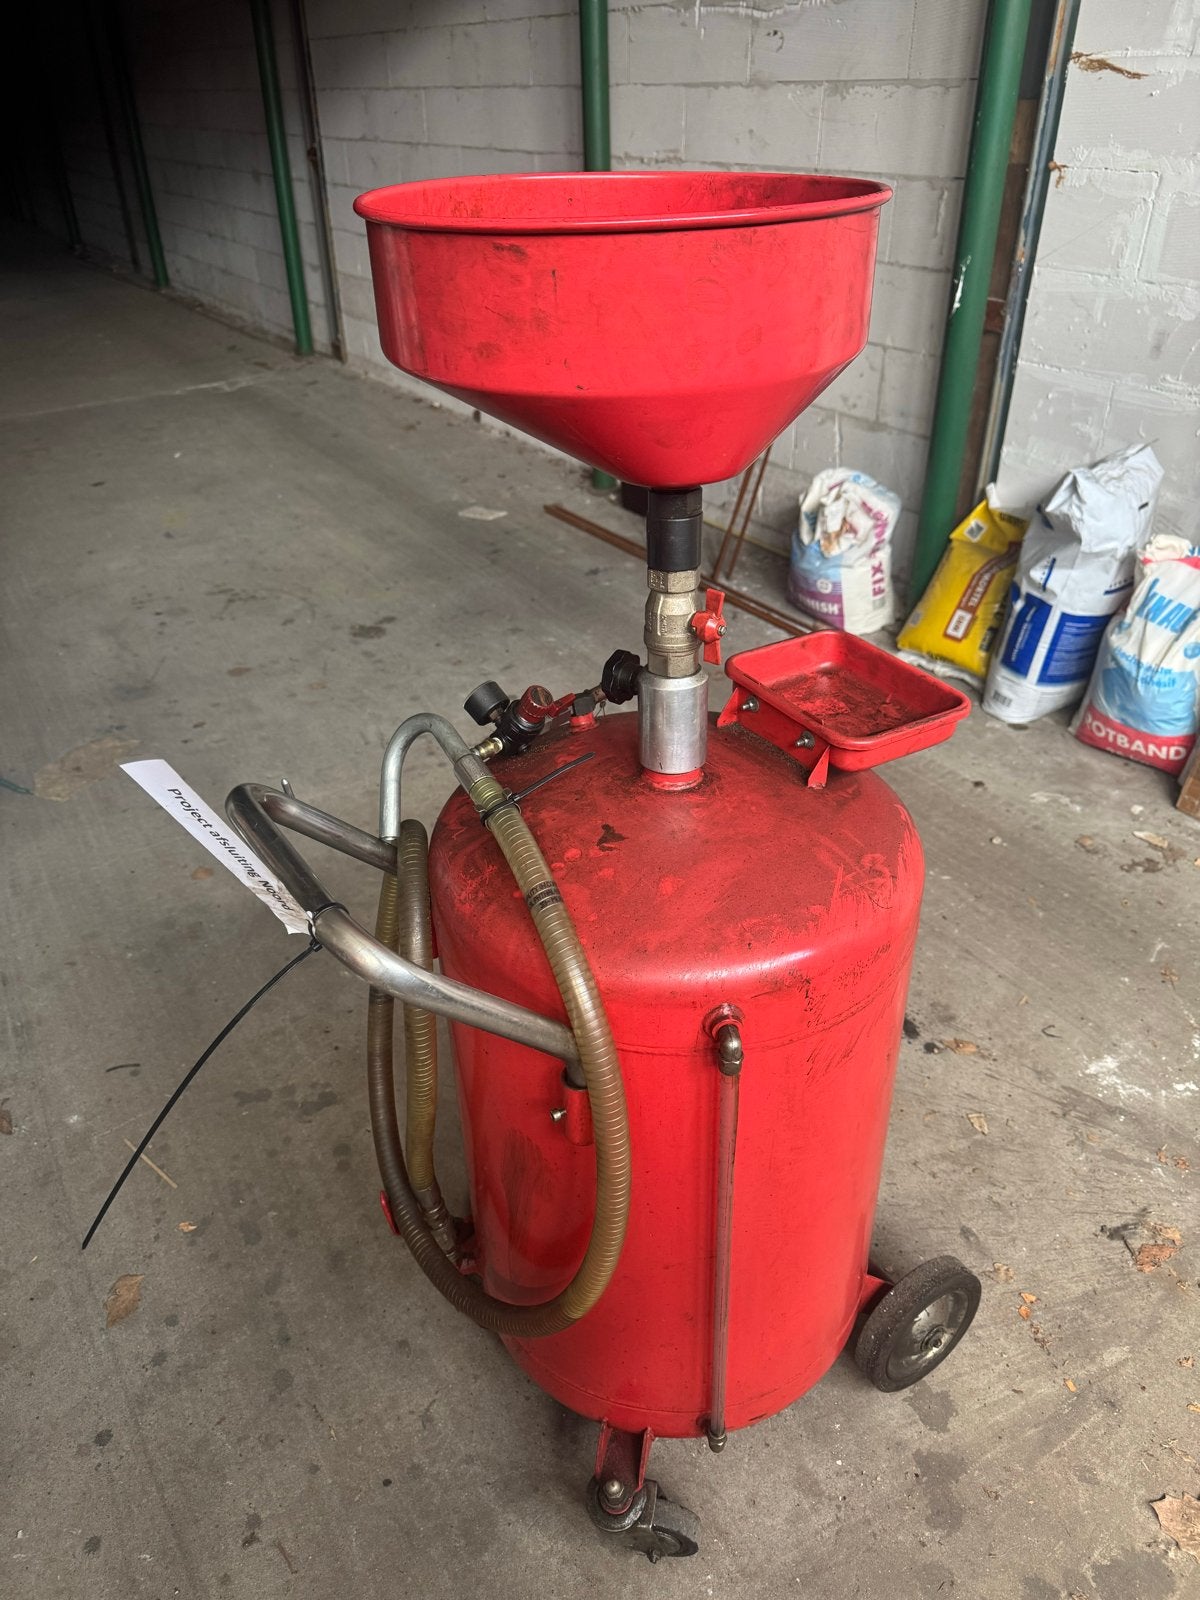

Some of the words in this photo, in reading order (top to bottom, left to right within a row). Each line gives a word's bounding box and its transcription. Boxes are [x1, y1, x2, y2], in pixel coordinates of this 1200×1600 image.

[871, 562, 887, 598] FIX
[1136, 577, 1198, 634] KNAU
[167, 788, 213, 829] Project
[209, 830, 262, 880] afsluiting
[258, 880, 294, 911] Noord
